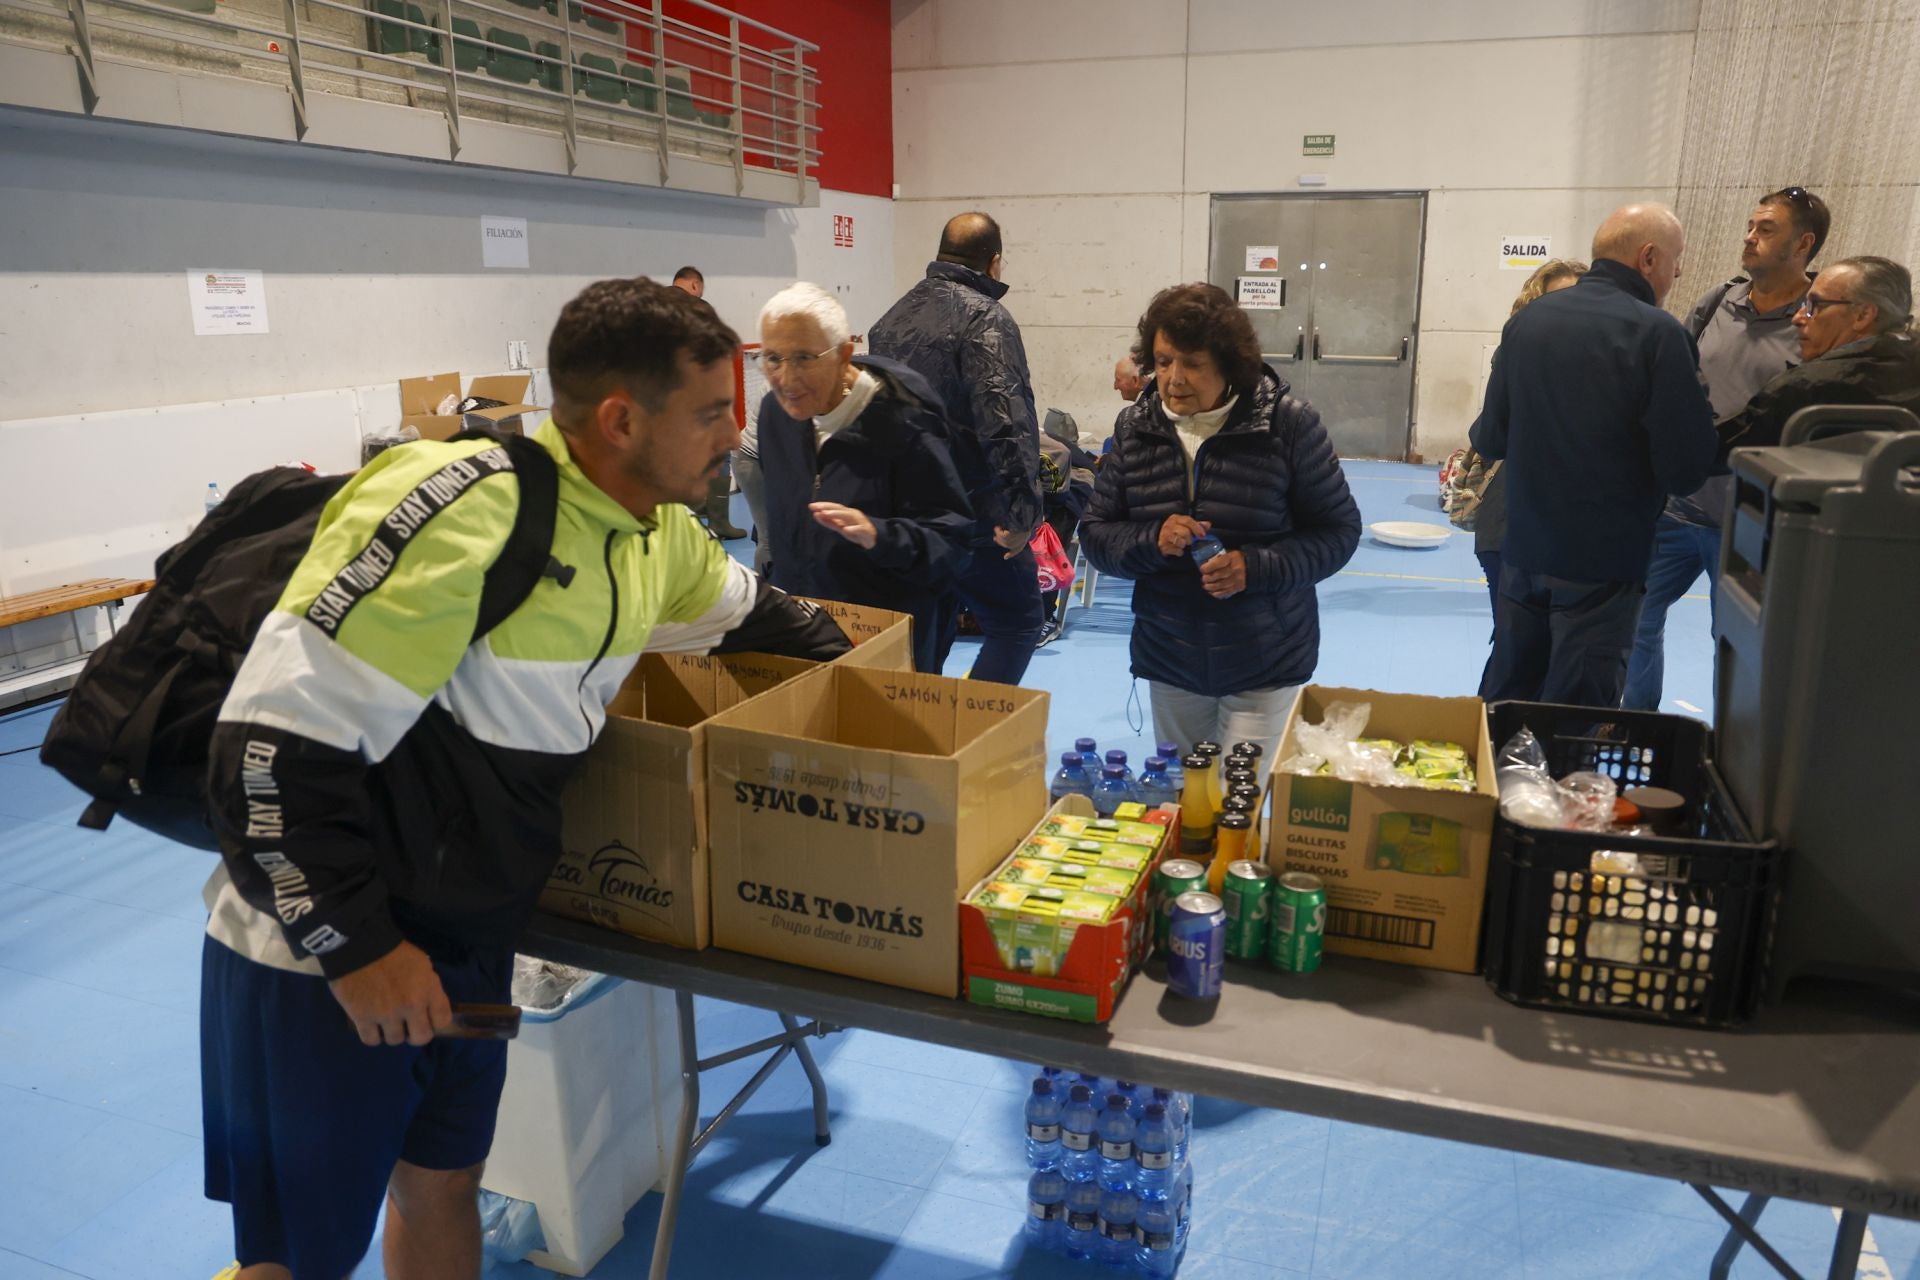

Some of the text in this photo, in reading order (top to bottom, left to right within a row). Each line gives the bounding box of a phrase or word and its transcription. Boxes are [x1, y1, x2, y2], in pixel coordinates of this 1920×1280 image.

[486, 226, 523, 239] FILIACIÓN
[1503, 244, 1547, 256] SALIDA
[385, 458, 480, 540] STAY TUNED
[308, 537, 395, 631] STAY TUNED
[884, 685, 941, 704] JAMÓN
[242, 740, 278, 797] TUNED
[843, 801, 926, 836] CASA
[1291, 808, 1348, 827] gullón
[1287, 833, 1347, 850] GALLETAS
[1286, 848, 1338, 863] BISCUITS
[1285, 861, 1349, 879] BOLACHAS
[588, 857, 674, 908] Tomás
[737, 880, 810, 916] CASA
[771, 913, 886, 951] Grupo desde 1936
[994, 983, 1024, 997] ZUMO
